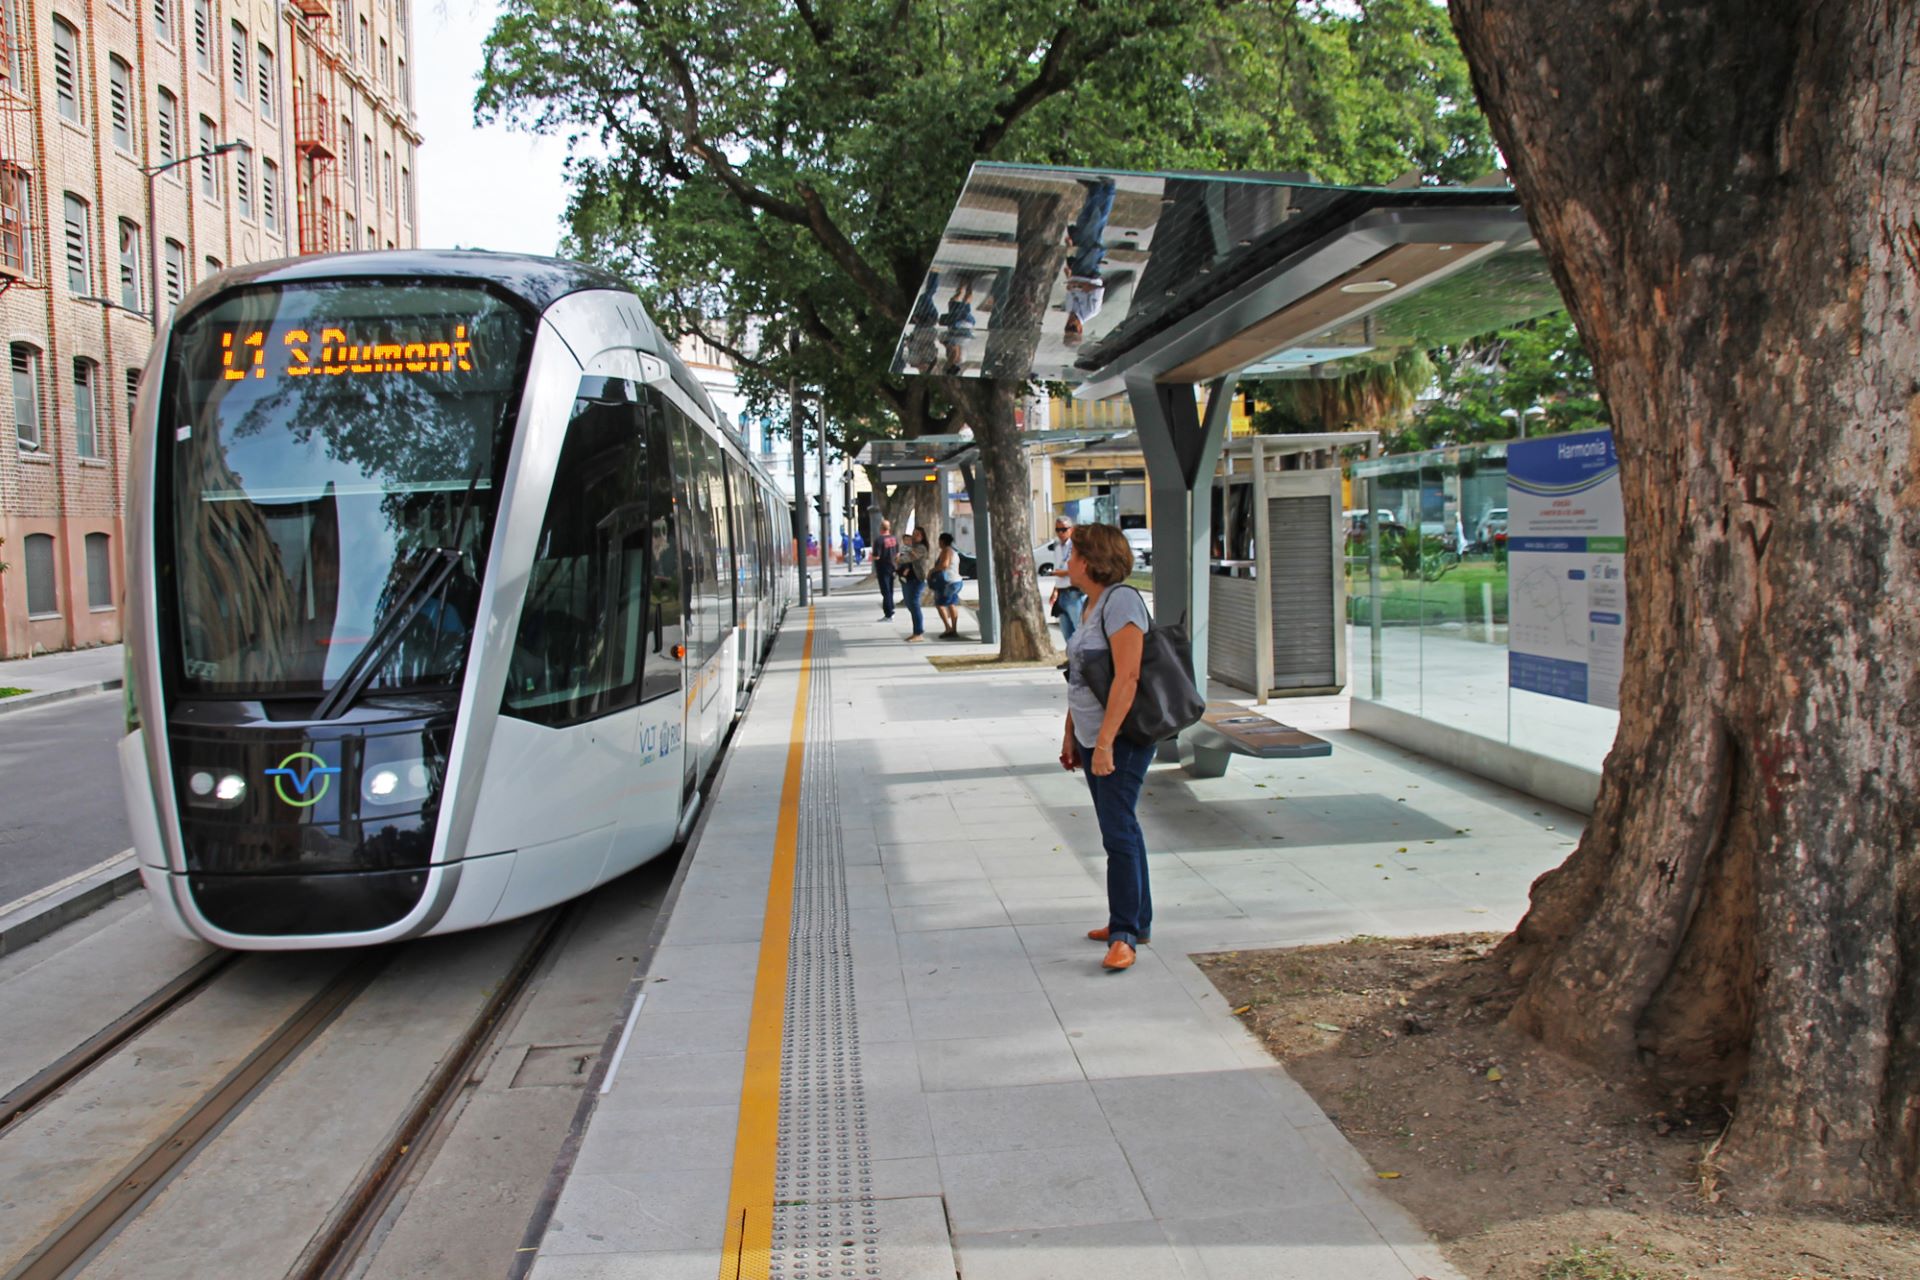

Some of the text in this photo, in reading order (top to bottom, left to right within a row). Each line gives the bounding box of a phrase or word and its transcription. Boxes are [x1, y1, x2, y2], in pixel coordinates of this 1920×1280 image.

[222, 325, 472, 379] L1 S.Dumont
[1558, 438, 1607, 459] Harmonia
